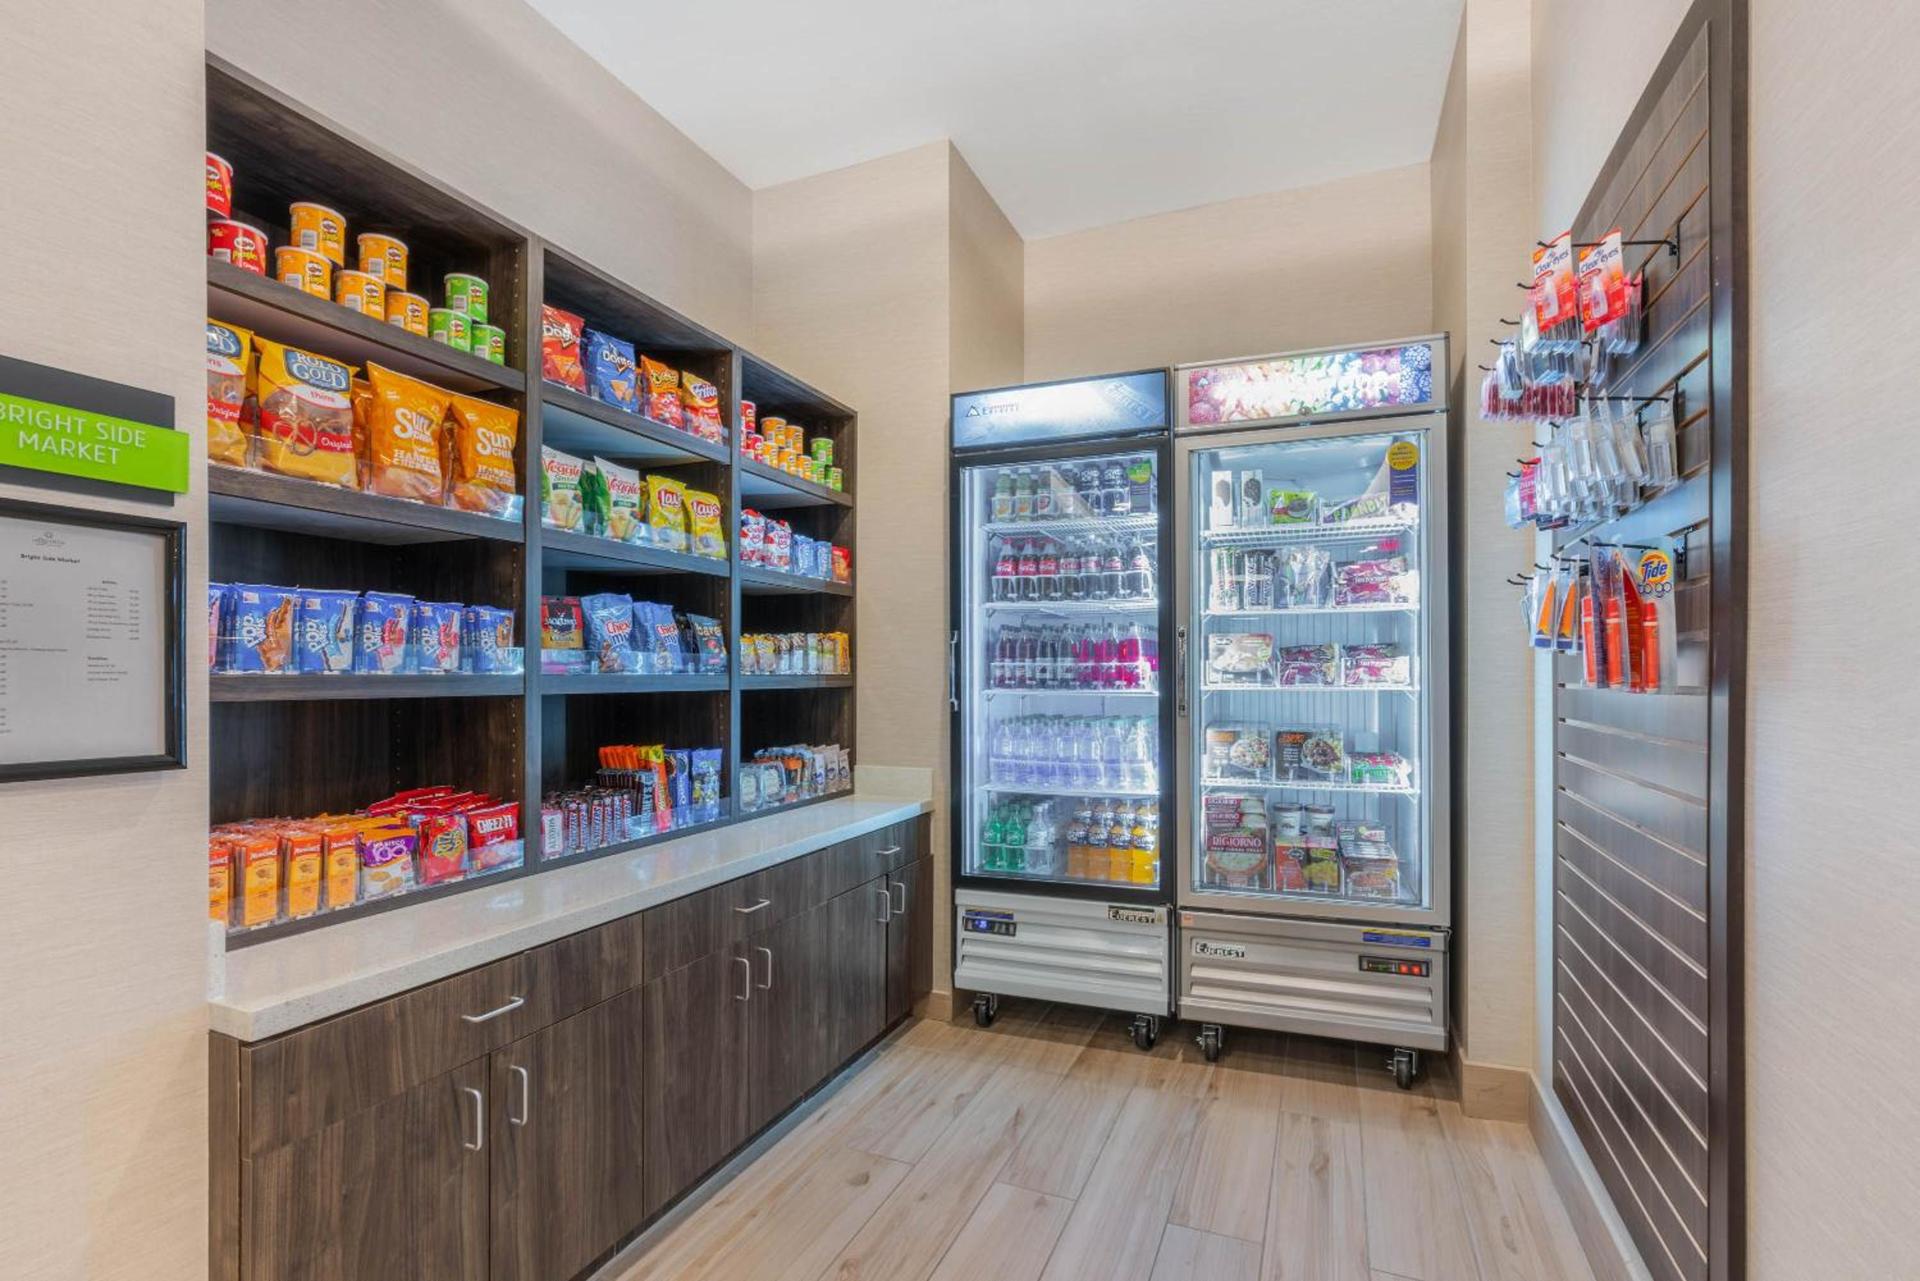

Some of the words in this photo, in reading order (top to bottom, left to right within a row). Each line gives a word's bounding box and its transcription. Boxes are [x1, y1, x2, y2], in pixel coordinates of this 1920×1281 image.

[1553, 251, 1570, 266] eyes
[1581, 259, 1601, 274] Clear
[1601, 247, 1619, 263] eyes
[292, 363, 346, 389] GOLD
[0, 403, 87, 436] BRIGHT
[96, 422, 147, 448] SIDE
[393, 407, 433, 439] Sun
[18, 431, 121, 465] MARKET
[321, 436, 353, 450] Original
[476, 427, 513, 456] Sun
[1641, 560, 1668, 583] Tide
[1638, 581, 1653, 595] to
[1655, 581, 1673, 598] go
[476, 814, 513, 834] CHEEZ-IT
